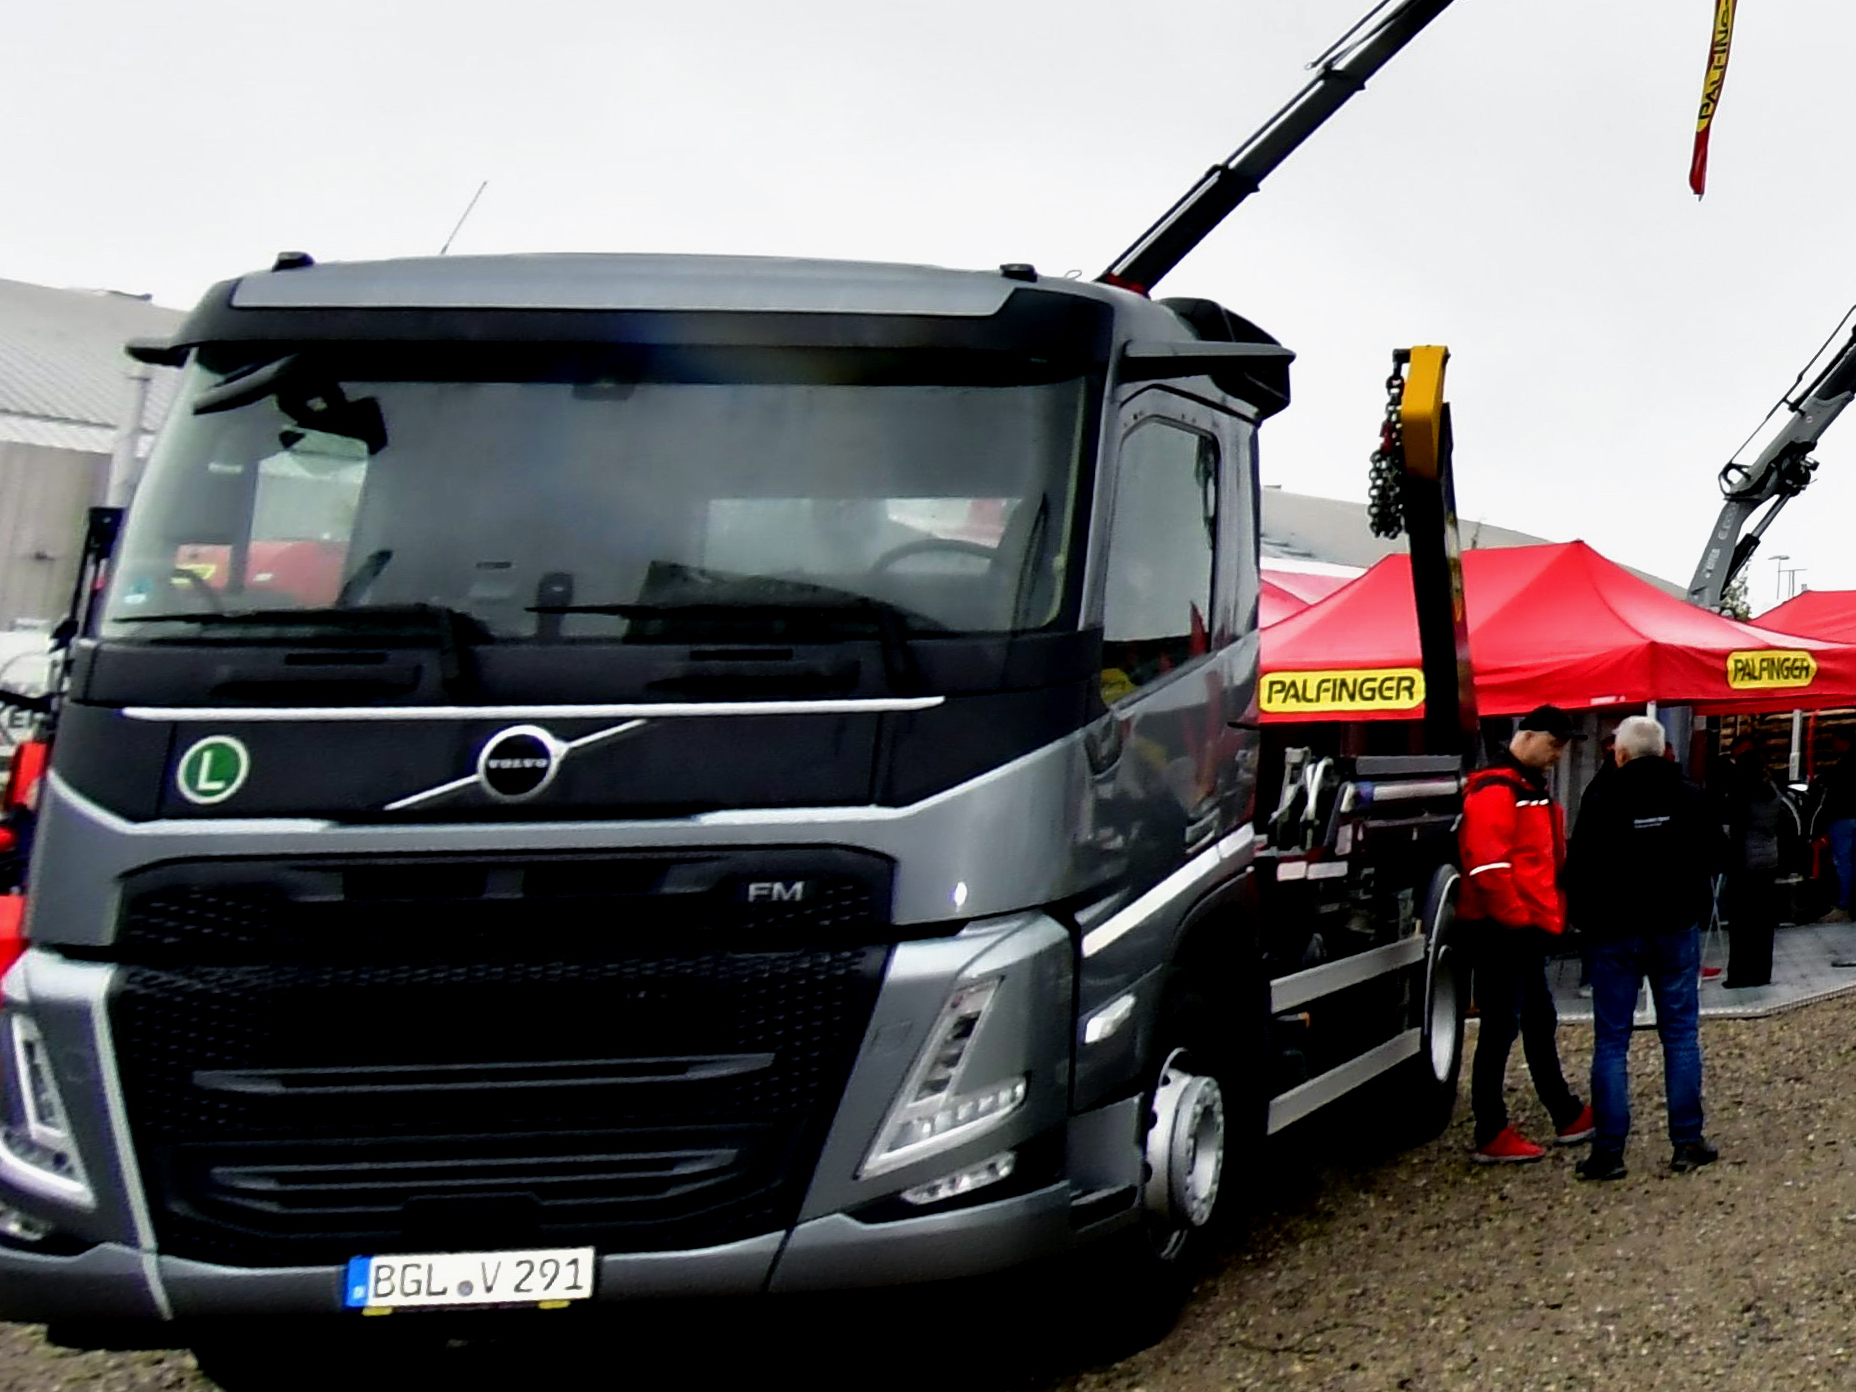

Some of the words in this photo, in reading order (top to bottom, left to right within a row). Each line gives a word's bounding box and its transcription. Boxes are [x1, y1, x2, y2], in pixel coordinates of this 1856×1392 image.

[1732, 657, 1810, 682] PALFINGER
[1267, 676, 1415, 704] PALFINGER
[198, 750, 225, 790] L
[488, 758, 548, 769] VOLVO
[748, 881, 805, 902] FM
[374, 1263, 448, 1298] BGL
[481, 1261, 502, 1294] V
[513, 1257, 584, 1293] 291
